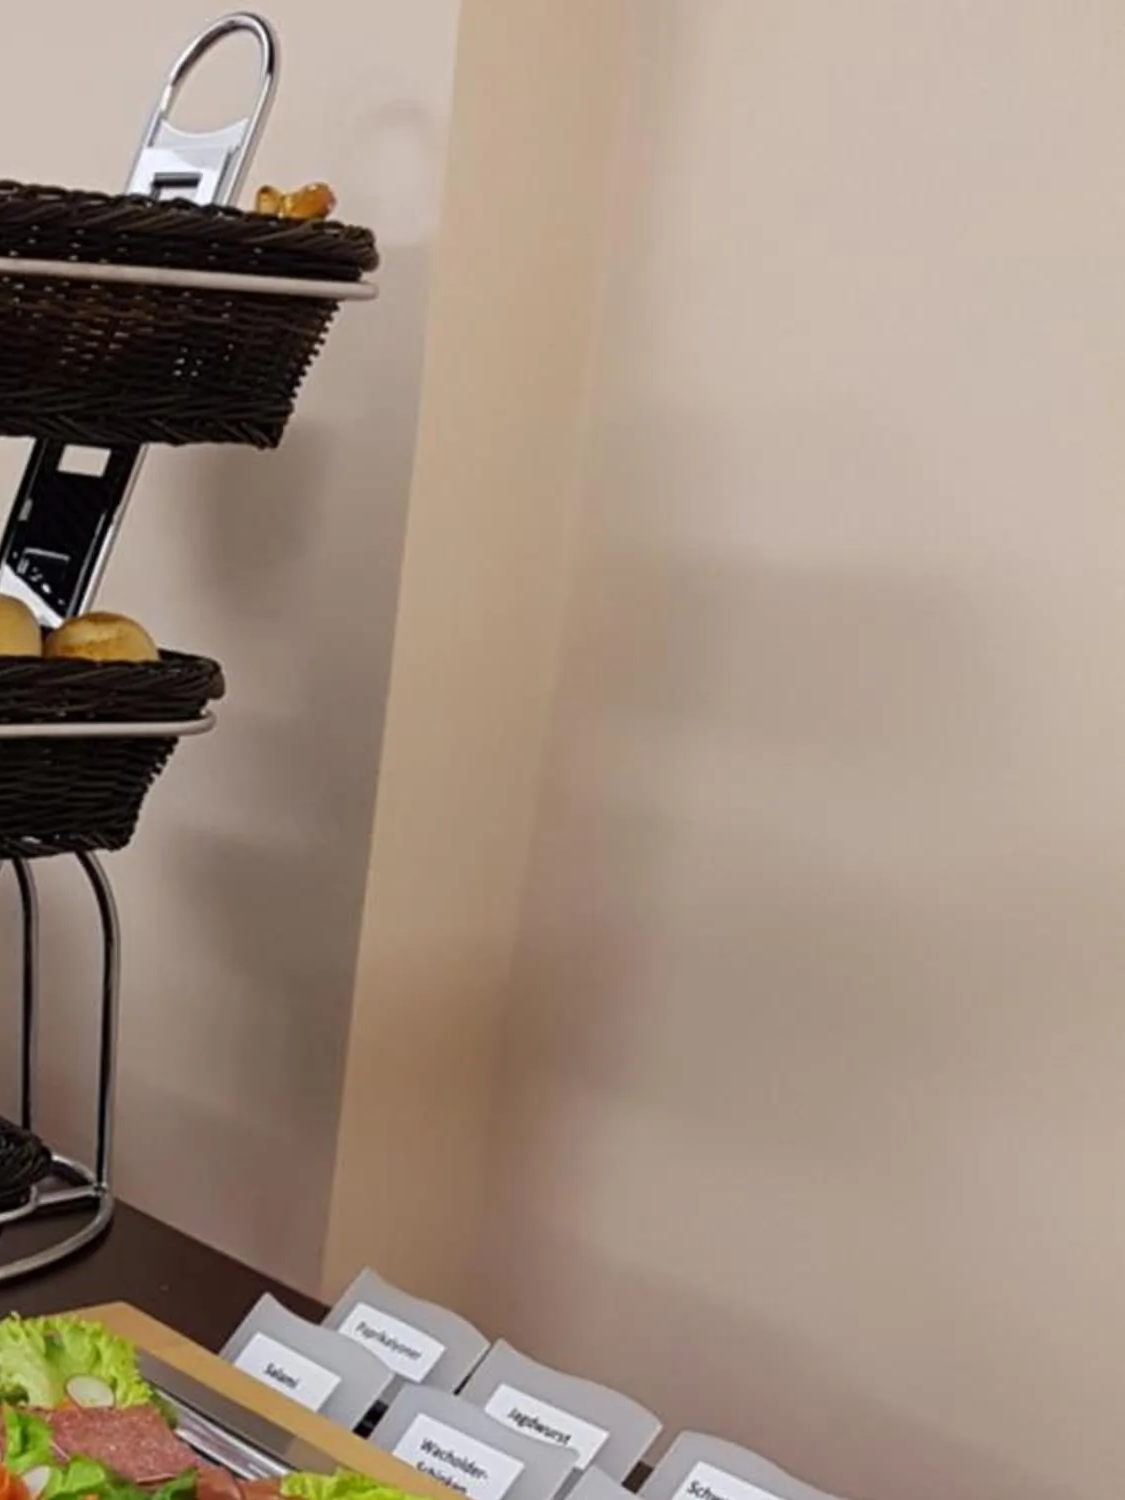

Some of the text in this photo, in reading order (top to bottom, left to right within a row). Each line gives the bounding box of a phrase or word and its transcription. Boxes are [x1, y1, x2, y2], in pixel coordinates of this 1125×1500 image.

[264, 1361, 301, 1389] Salami
[507, 1407, 572, 1445] Jagdwurst
[420, 1438, 488, 1480] Wacholder-
